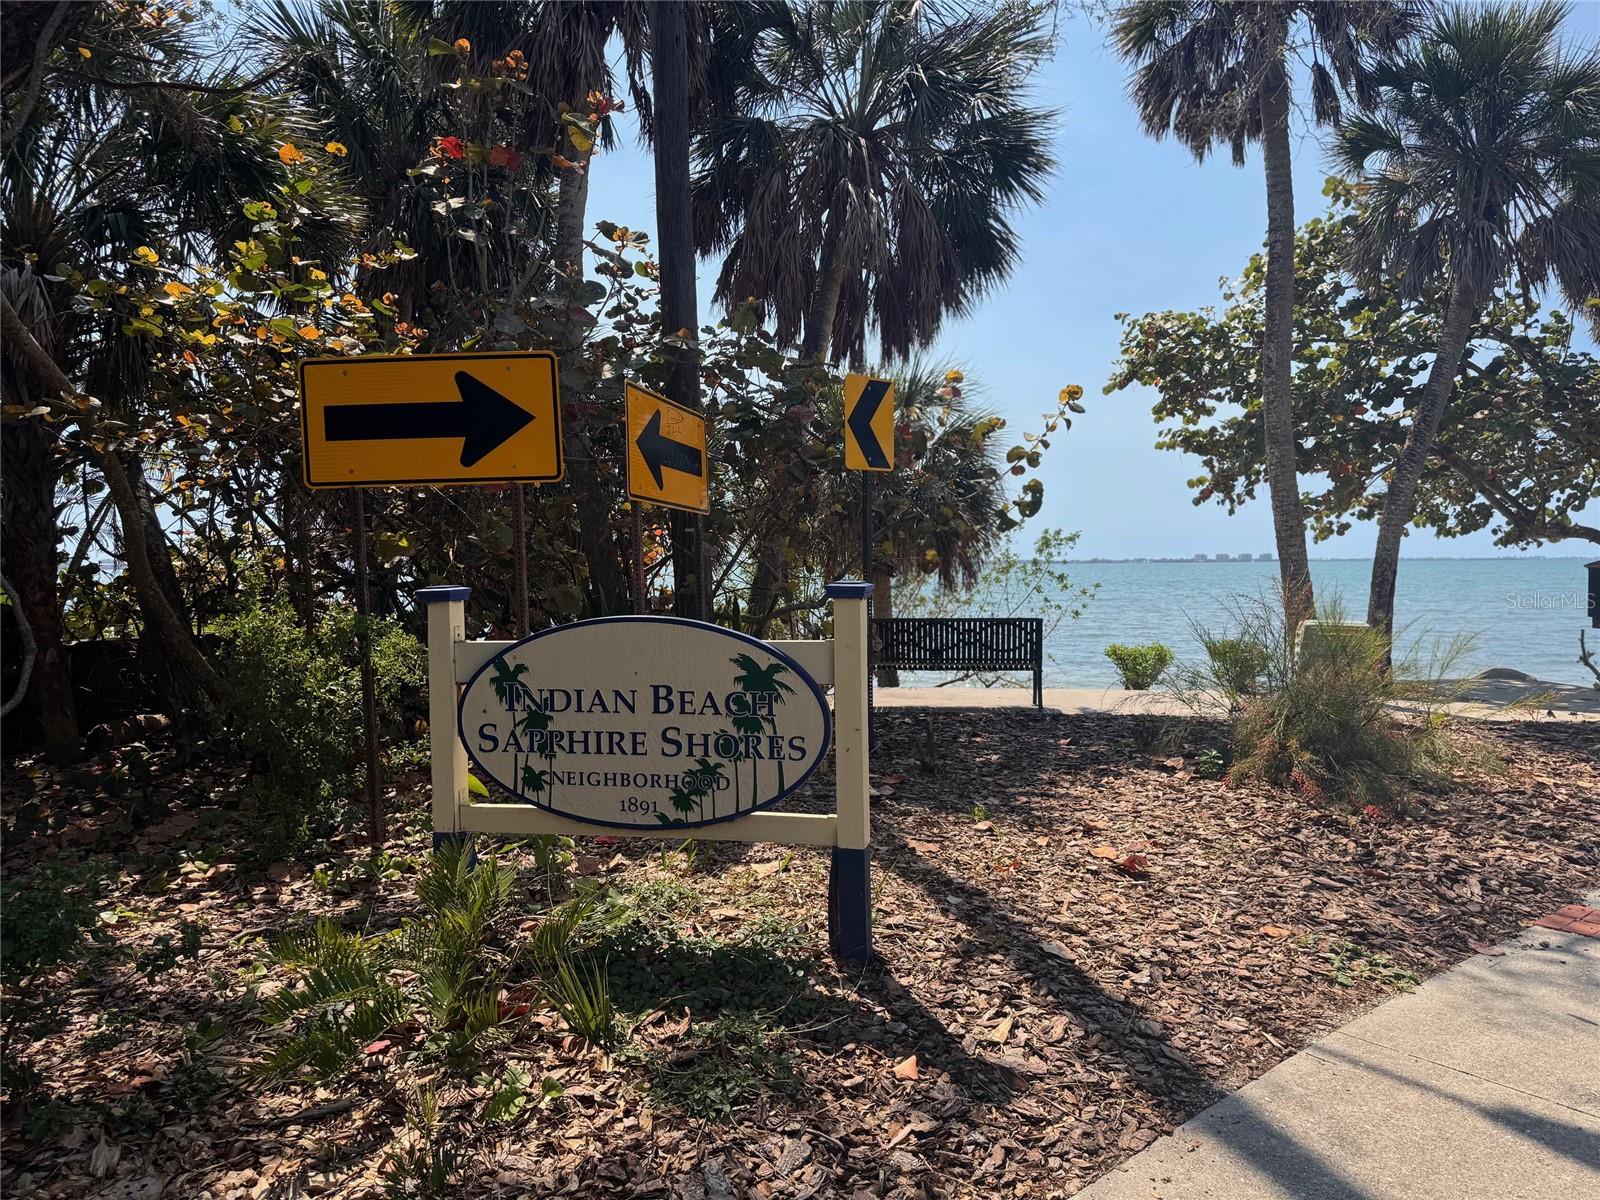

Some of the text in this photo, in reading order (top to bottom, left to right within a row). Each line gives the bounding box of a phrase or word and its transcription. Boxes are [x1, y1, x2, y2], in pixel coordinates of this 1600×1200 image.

[504, 682, 777, 717] INDIAN BEACH
[478, 723, 807, 761] SAPPHIRE SHORES
[551, 770, 731, 791] NEIGHBORHOOD
[619, 796, 658, 816] 1891
